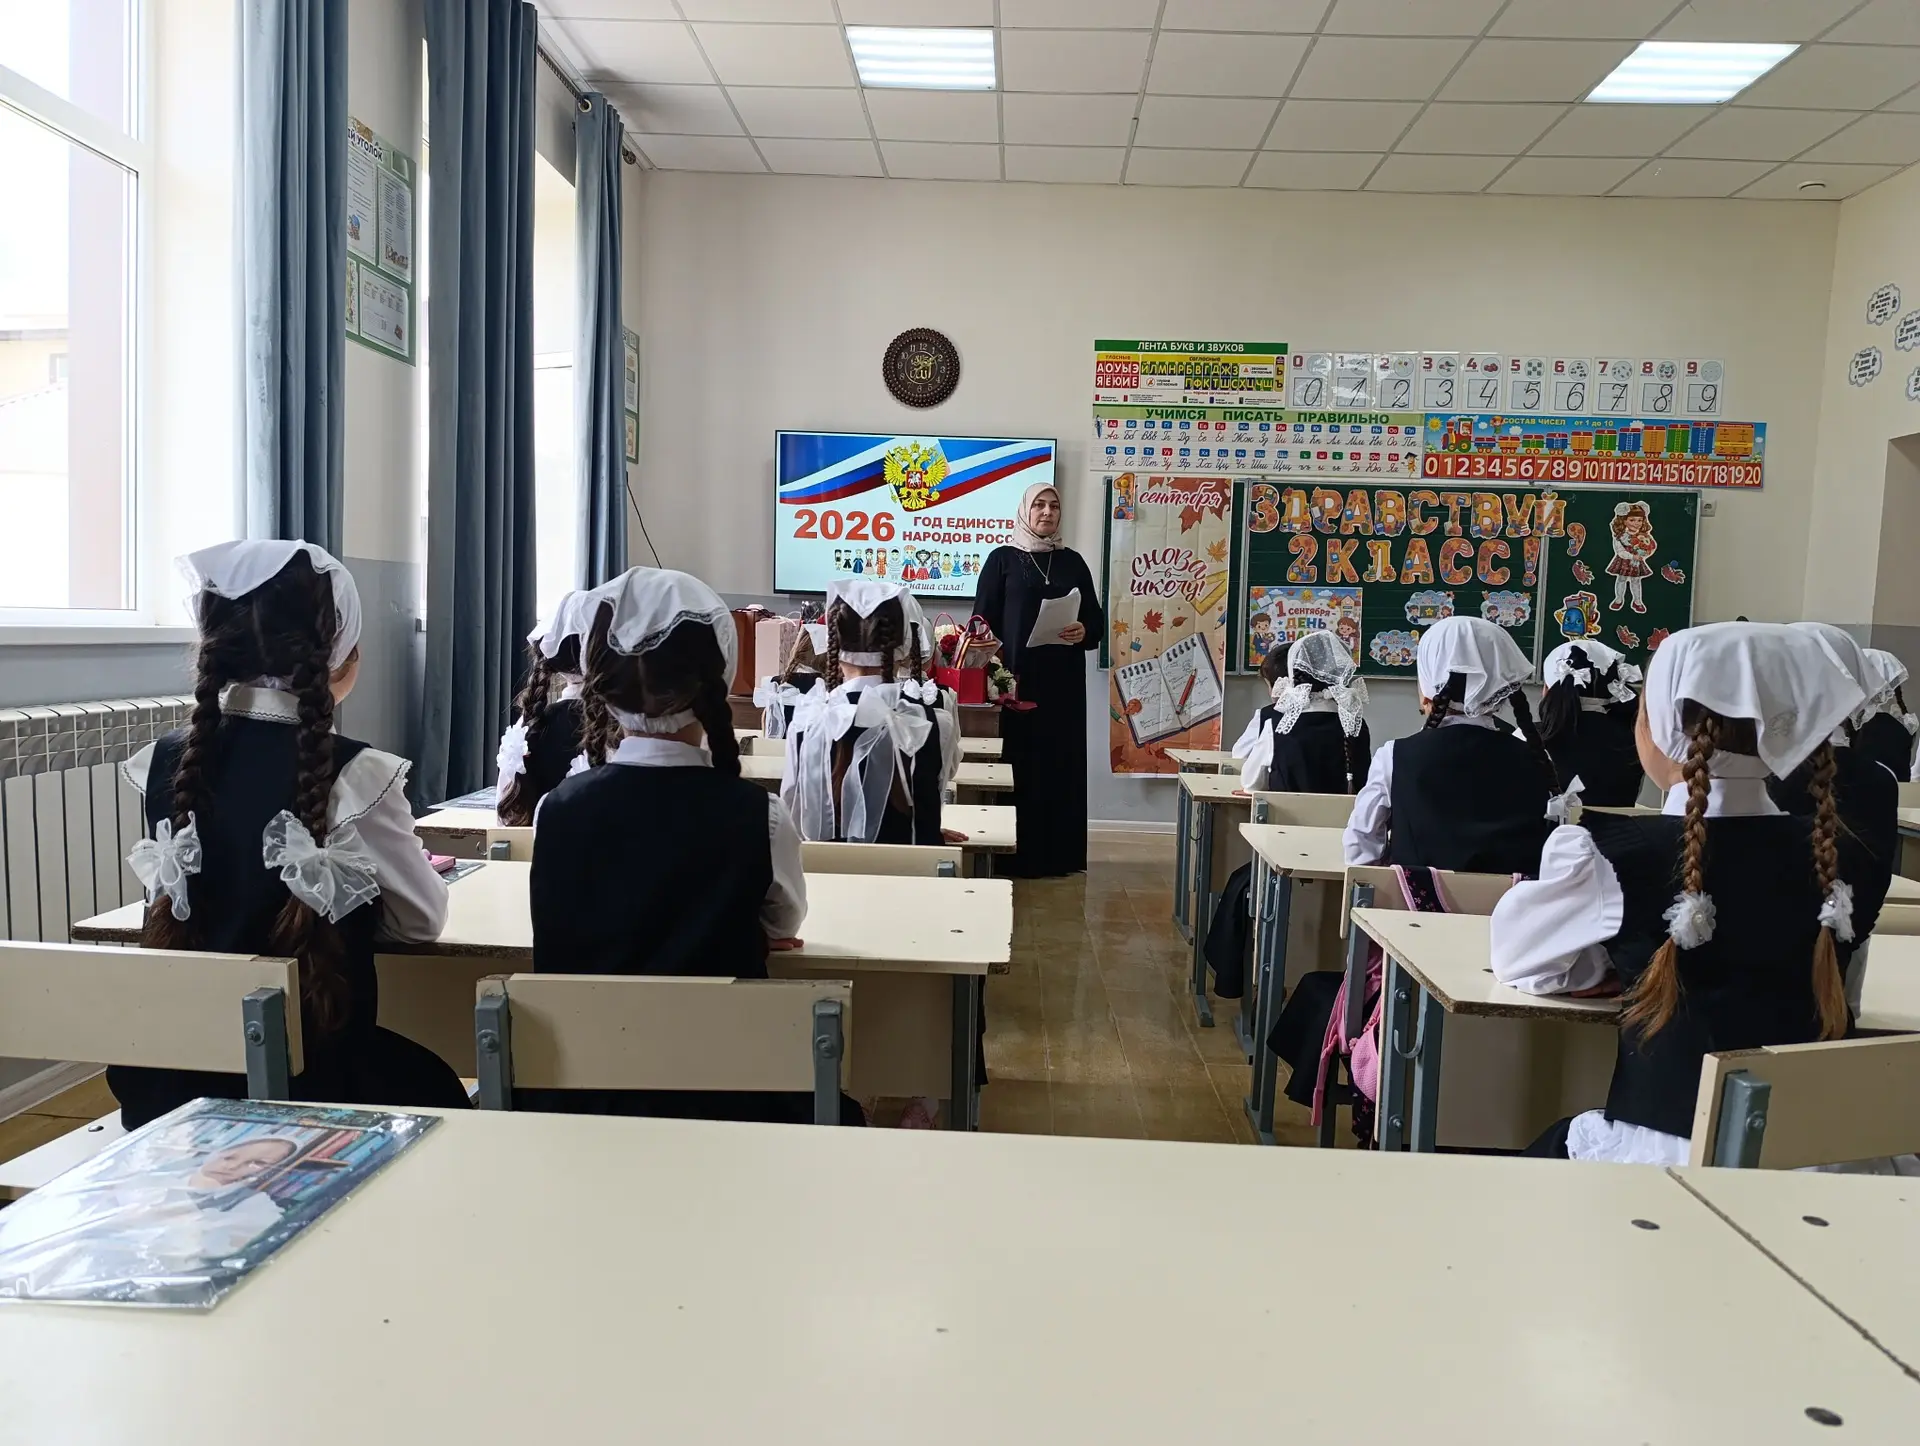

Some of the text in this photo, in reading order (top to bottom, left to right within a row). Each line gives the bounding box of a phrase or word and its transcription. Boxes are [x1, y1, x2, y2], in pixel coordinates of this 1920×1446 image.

[357, 135, 382, 162] УГОЛОК
[1138, 342, 1167, 350] ЛЕНТА
[1171, 342, 1194, 351] БУКВ
[1293, 355, 1303, 367] 0
[1339, 356, 1344, 367] 1
[1380, 358, 1389, 369] 2
[1423, 358, 1432, 369] 3
[1467, 358, 1477, 369] 4
[1511, 360, 1520, 371] 5
[1555, 361, 1564, 372] 6
[1599, 361, 1608, 373] 7
[1642, 362, 1653, 373] 8
[1687, 362, 1697, 374] 9
[1304, 378, 1322, 406] 0
[1350, 378, 1366, 406] 1
[1392, 380, 1410, 407] 2
[1436, 380, 1453, 407] 3
[1480, 380, 1497, 408] 4
[1523, 381, 1540, 409] 5
[1567, 383, 1585, 411] 6
[1611, 383, 1628, 411] 7
[1654, 384, 1672, 412] 8
[1699, 385, 1717, 412] 9
[1146, 408, 1390, 424] УЧИМСЯ ПИСАТЬ ПРАВИЛЬНО
[1425, 457, 1761, 484] 0 1 2 3 4 5 6 7 8 9 10 11 12 13 14 15 16 17 18 19 20
[1140, 482, 1220, 510] сентября
[793, 508, 896, 542] 2026
[913, 516, 943, 529] ГОД
[902, 530, 974, 544] НАРОДОВ
[1286, 534, 1541, 586] 2 КЛАСС!
[938, 582, 964, 591] сила!
[1275, 601, 1286, 617] 1
[1289, 608, 1330, 616] сентября
[1286, 617, 1326, 629] ДЕНЬ
[1278, 631, 1315, 642] ЗНА
